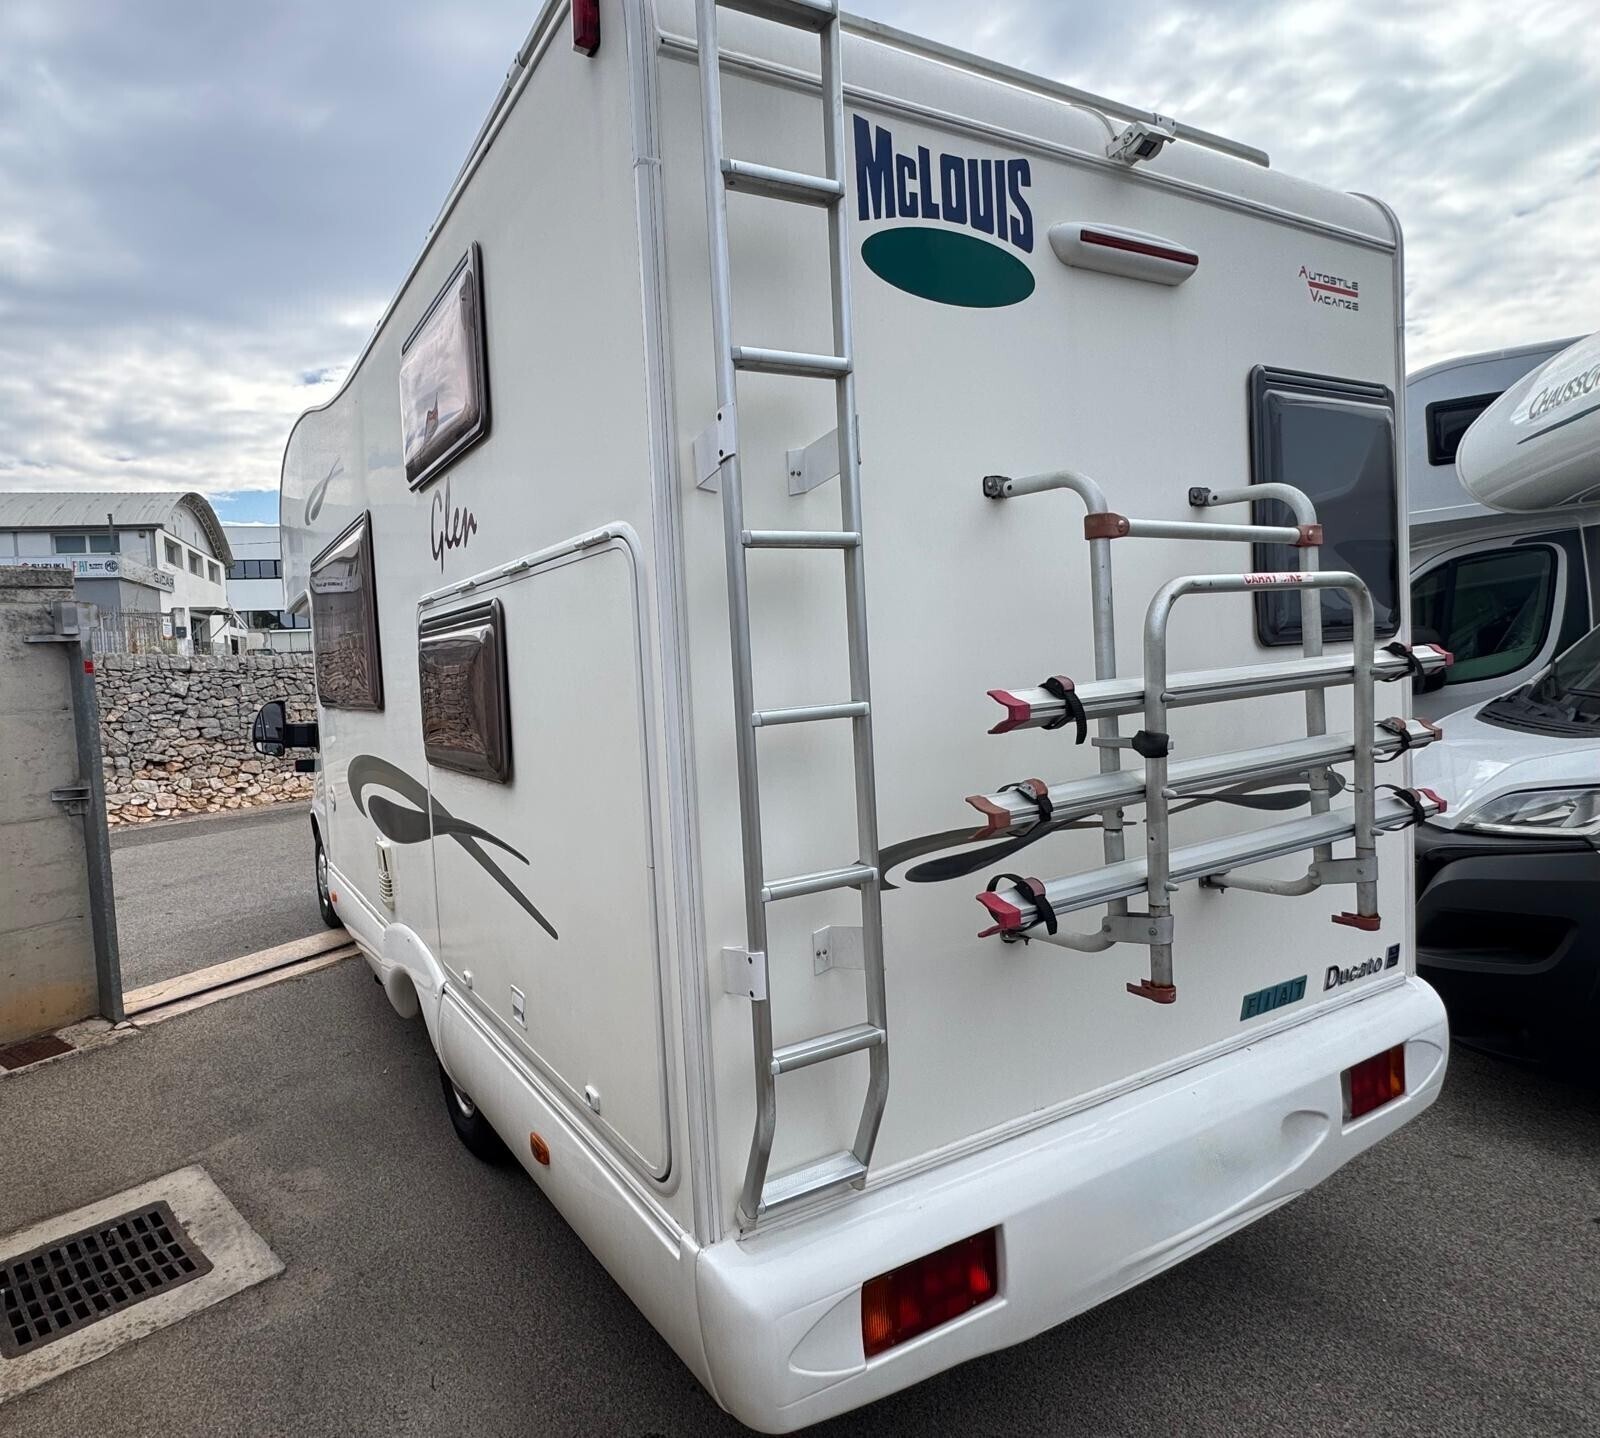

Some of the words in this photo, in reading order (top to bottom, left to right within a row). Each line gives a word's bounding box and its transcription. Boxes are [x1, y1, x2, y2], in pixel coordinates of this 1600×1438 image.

[431, 476, 478, 574] Glen
[1323, 957, 1383, 992] Ducato
[1243, 977, 1306, 1017] FIAT
